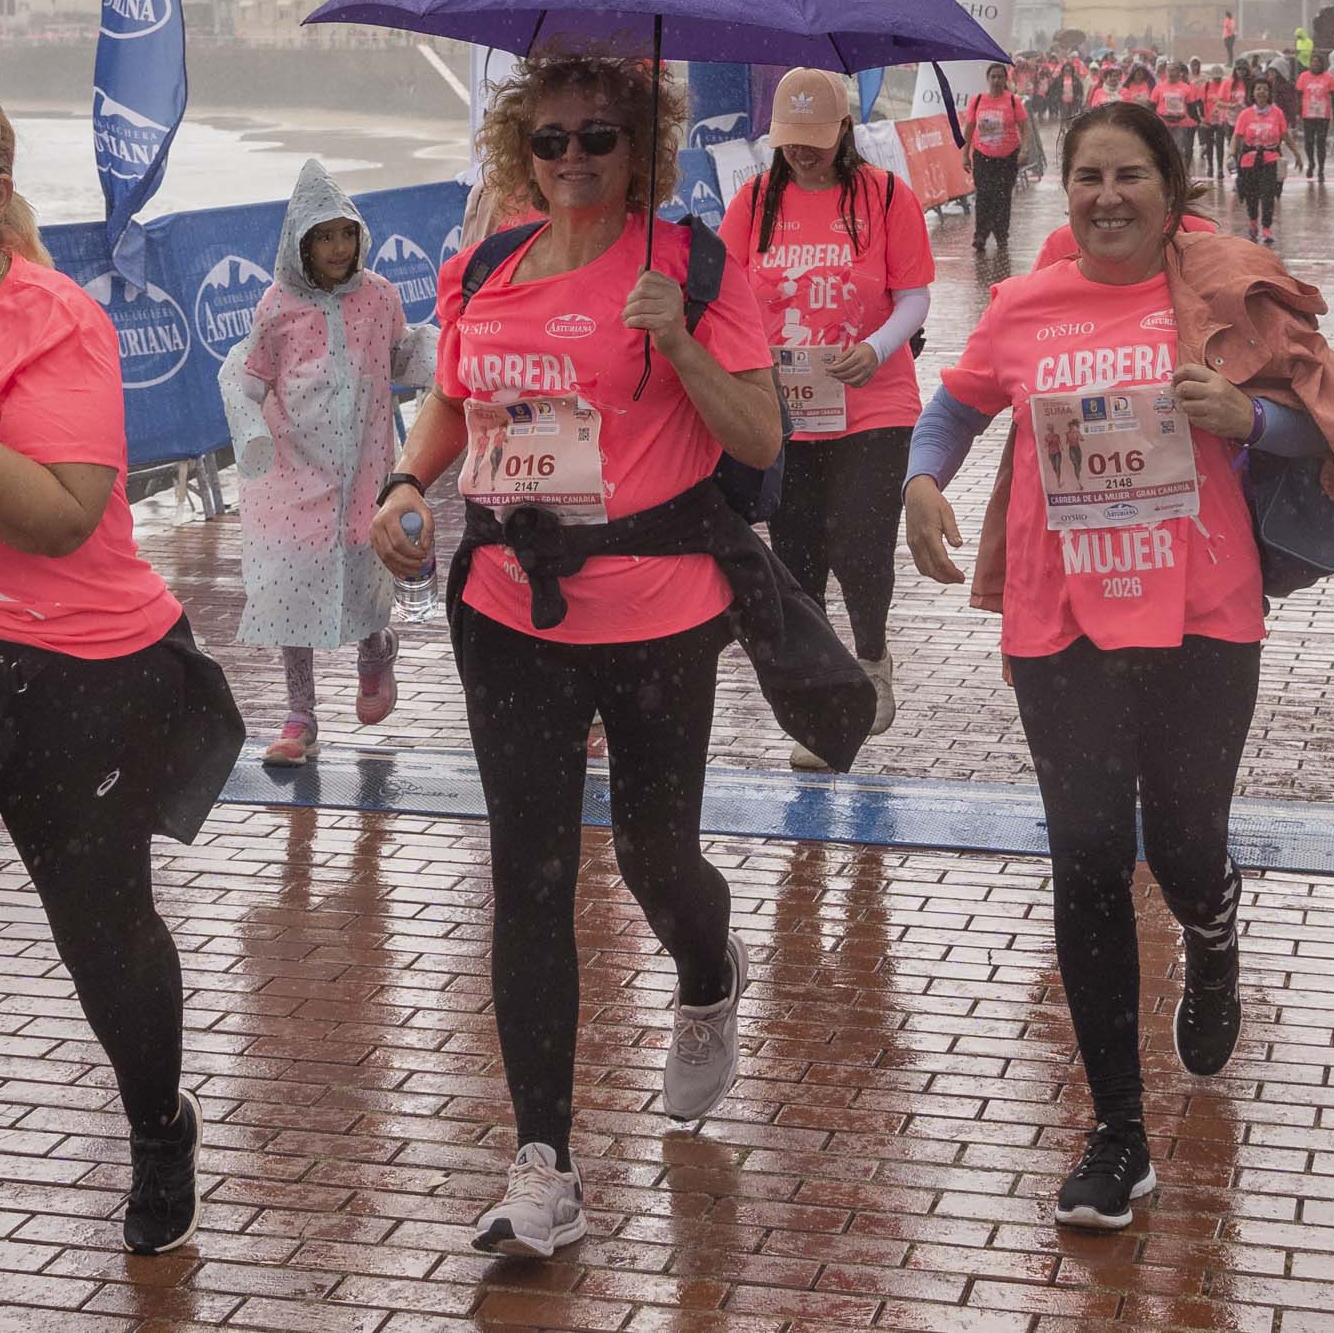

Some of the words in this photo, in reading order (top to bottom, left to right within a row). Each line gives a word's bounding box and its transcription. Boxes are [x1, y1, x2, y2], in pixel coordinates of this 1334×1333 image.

[810, 277, 840, 309] DE
[1036, 322, 1094, 341] OYSHO
[505, 454, 555, 477] 016
[1088, 450, 1146, 475] 016
[515, 481, 539, 491] 2147
[1105, 478, 1133, 490] 2148
[1051, 494, 1081, 505] CARRERA
[1083, 494, 1091, 503] DE
[1093, 493, 1103, 502] LA
[1105, 492, 1130, 501] MUJER
[1136, 489, 1157, 498] GRAN
[1158, 485, 1190, 496] CANARIA
[1061, 529, 1175, 575] MUJER
[1103, 578, 1142, 598] 2026
